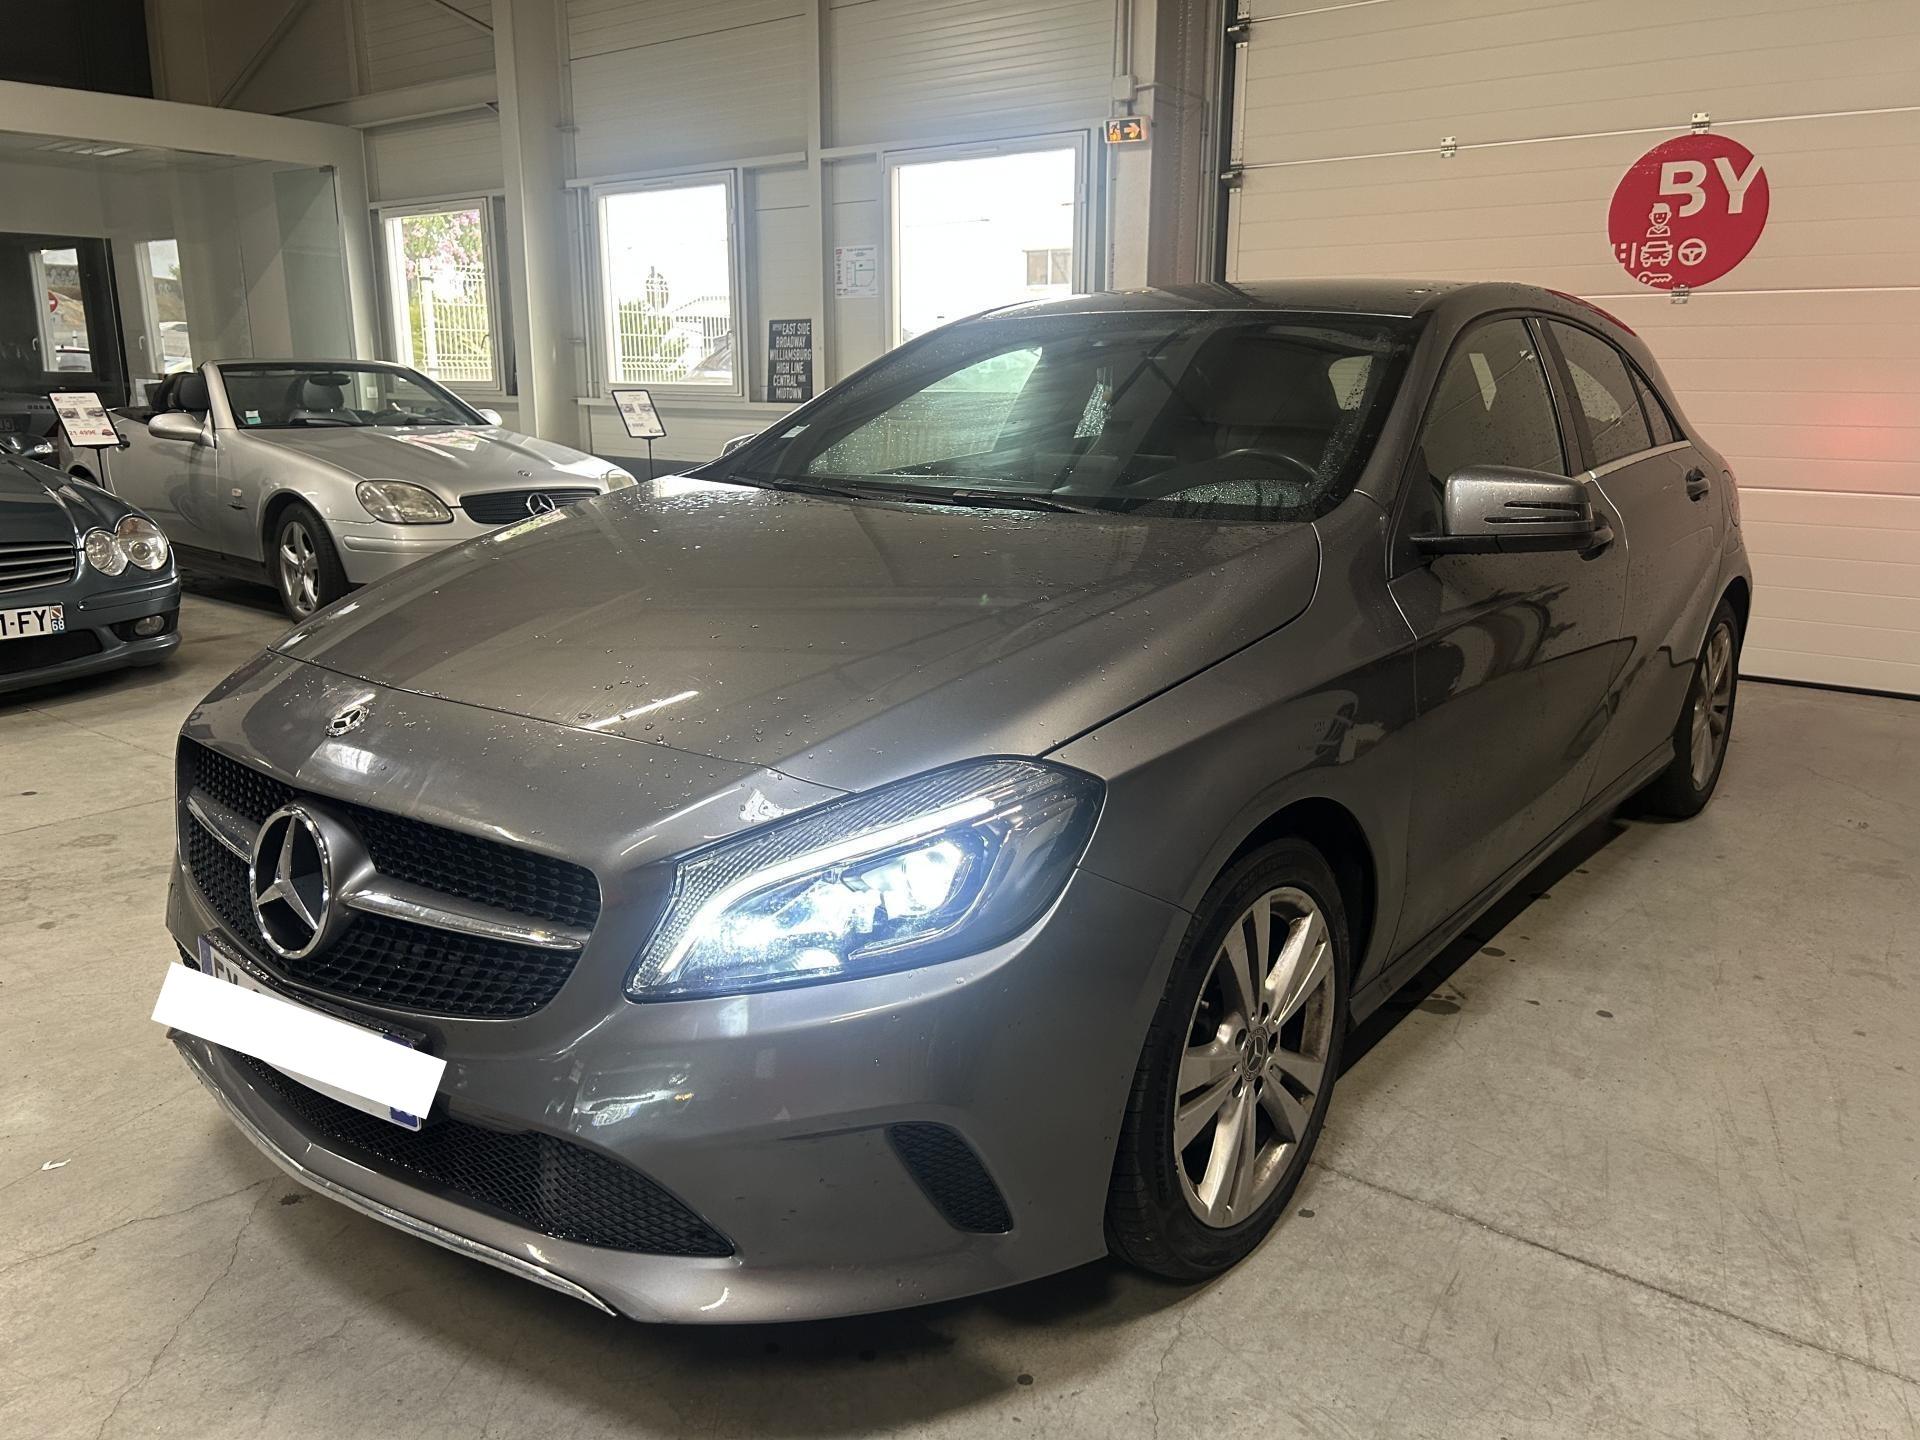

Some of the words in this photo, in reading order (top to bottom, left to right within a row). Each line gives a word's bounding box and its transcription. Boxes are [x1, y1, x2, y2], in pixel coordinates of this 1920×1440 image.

[1659, 155, 1763, 218] BY
[782, 323, 796, 335] EAST
[797, 322, 811, 335] SIDE
[776, 336, 806, 348] BROADWAY
[769, 349, 811, 361] WILLIAMSBURG
[776, 361, 789, 374] HIGH
[790, 361, 804, 374] LINE
[773, 374, 798, 387] CENTRAL
[775, 387, 802, 399] MIDTOWN
[51, 619, 65, 631] 68
